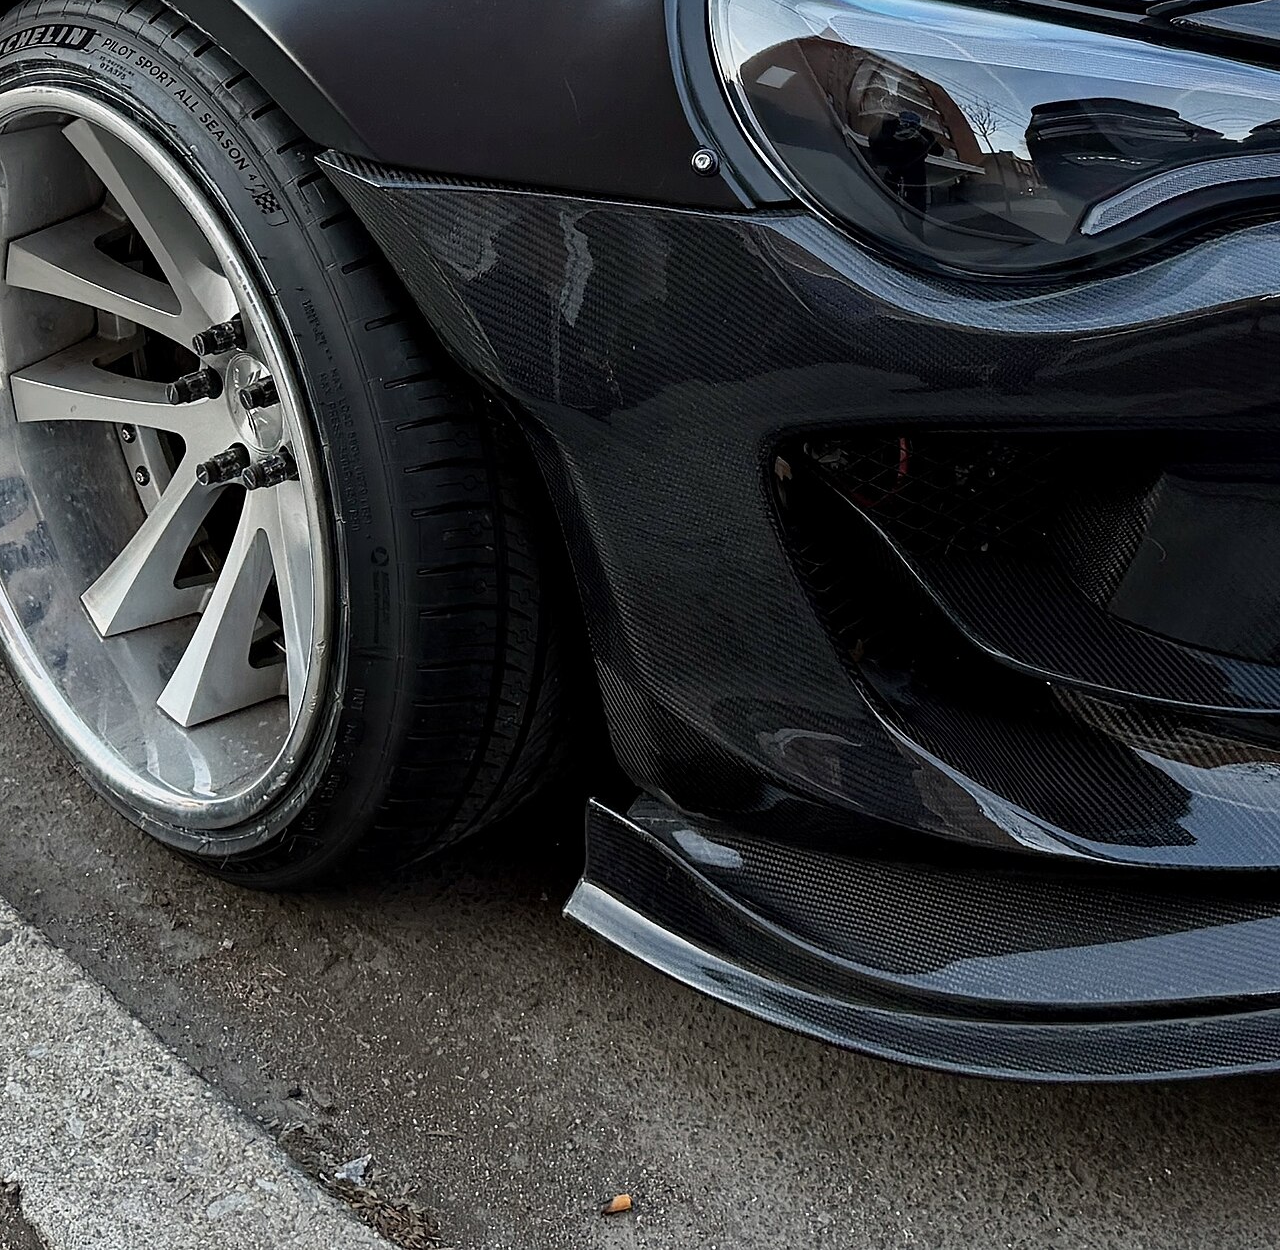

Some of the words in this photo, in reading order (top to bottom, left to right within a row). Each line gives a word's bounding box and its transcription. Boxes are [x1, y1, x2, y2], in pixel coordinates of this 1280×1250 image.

[101, 37, 137, 59] PILOT
[134, 55, 177, 88] SPORT
[173, 88, 200, 113] ALL
[199, 112, 250, 171] SEASON
